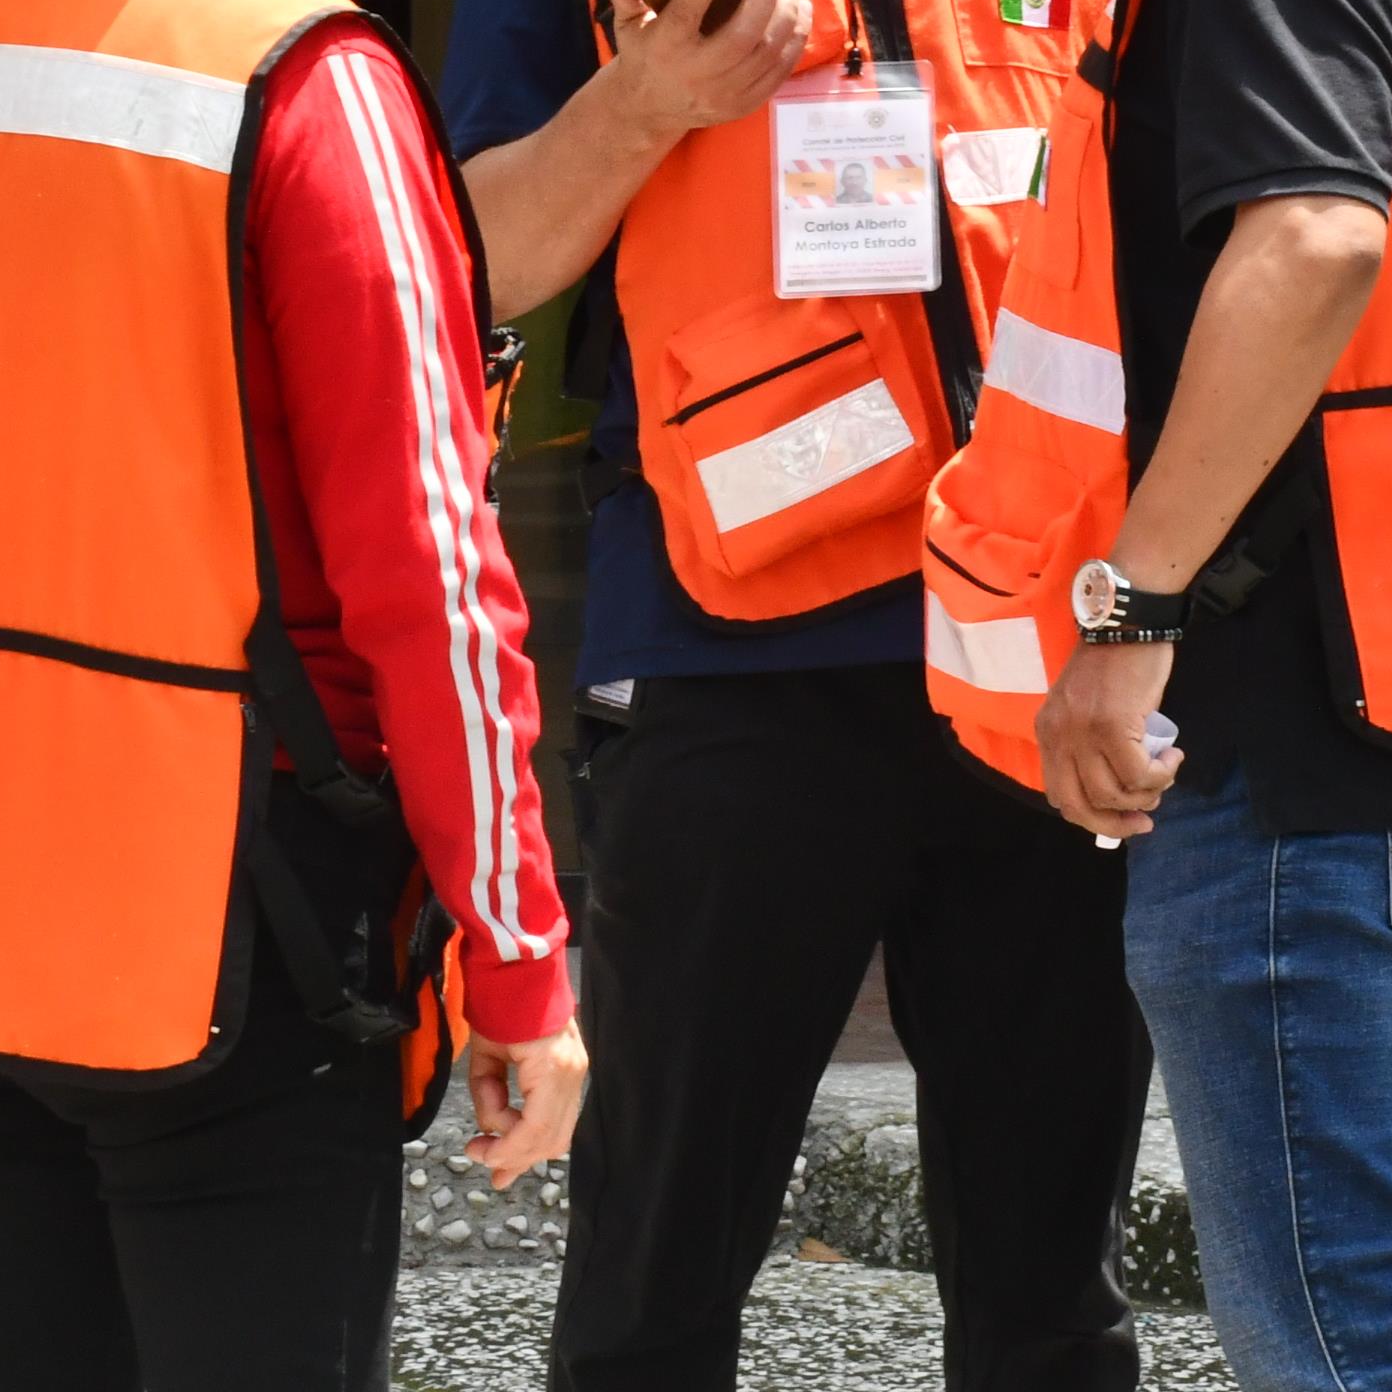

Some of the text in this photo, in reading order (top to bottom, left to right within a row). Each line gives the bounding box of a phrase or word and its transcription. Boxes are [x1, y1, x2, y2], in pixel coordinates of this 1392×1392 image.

[804, 217, 907, 233] Carlos Alberto
[794, 236, 917, 253] Montoya Estrada
